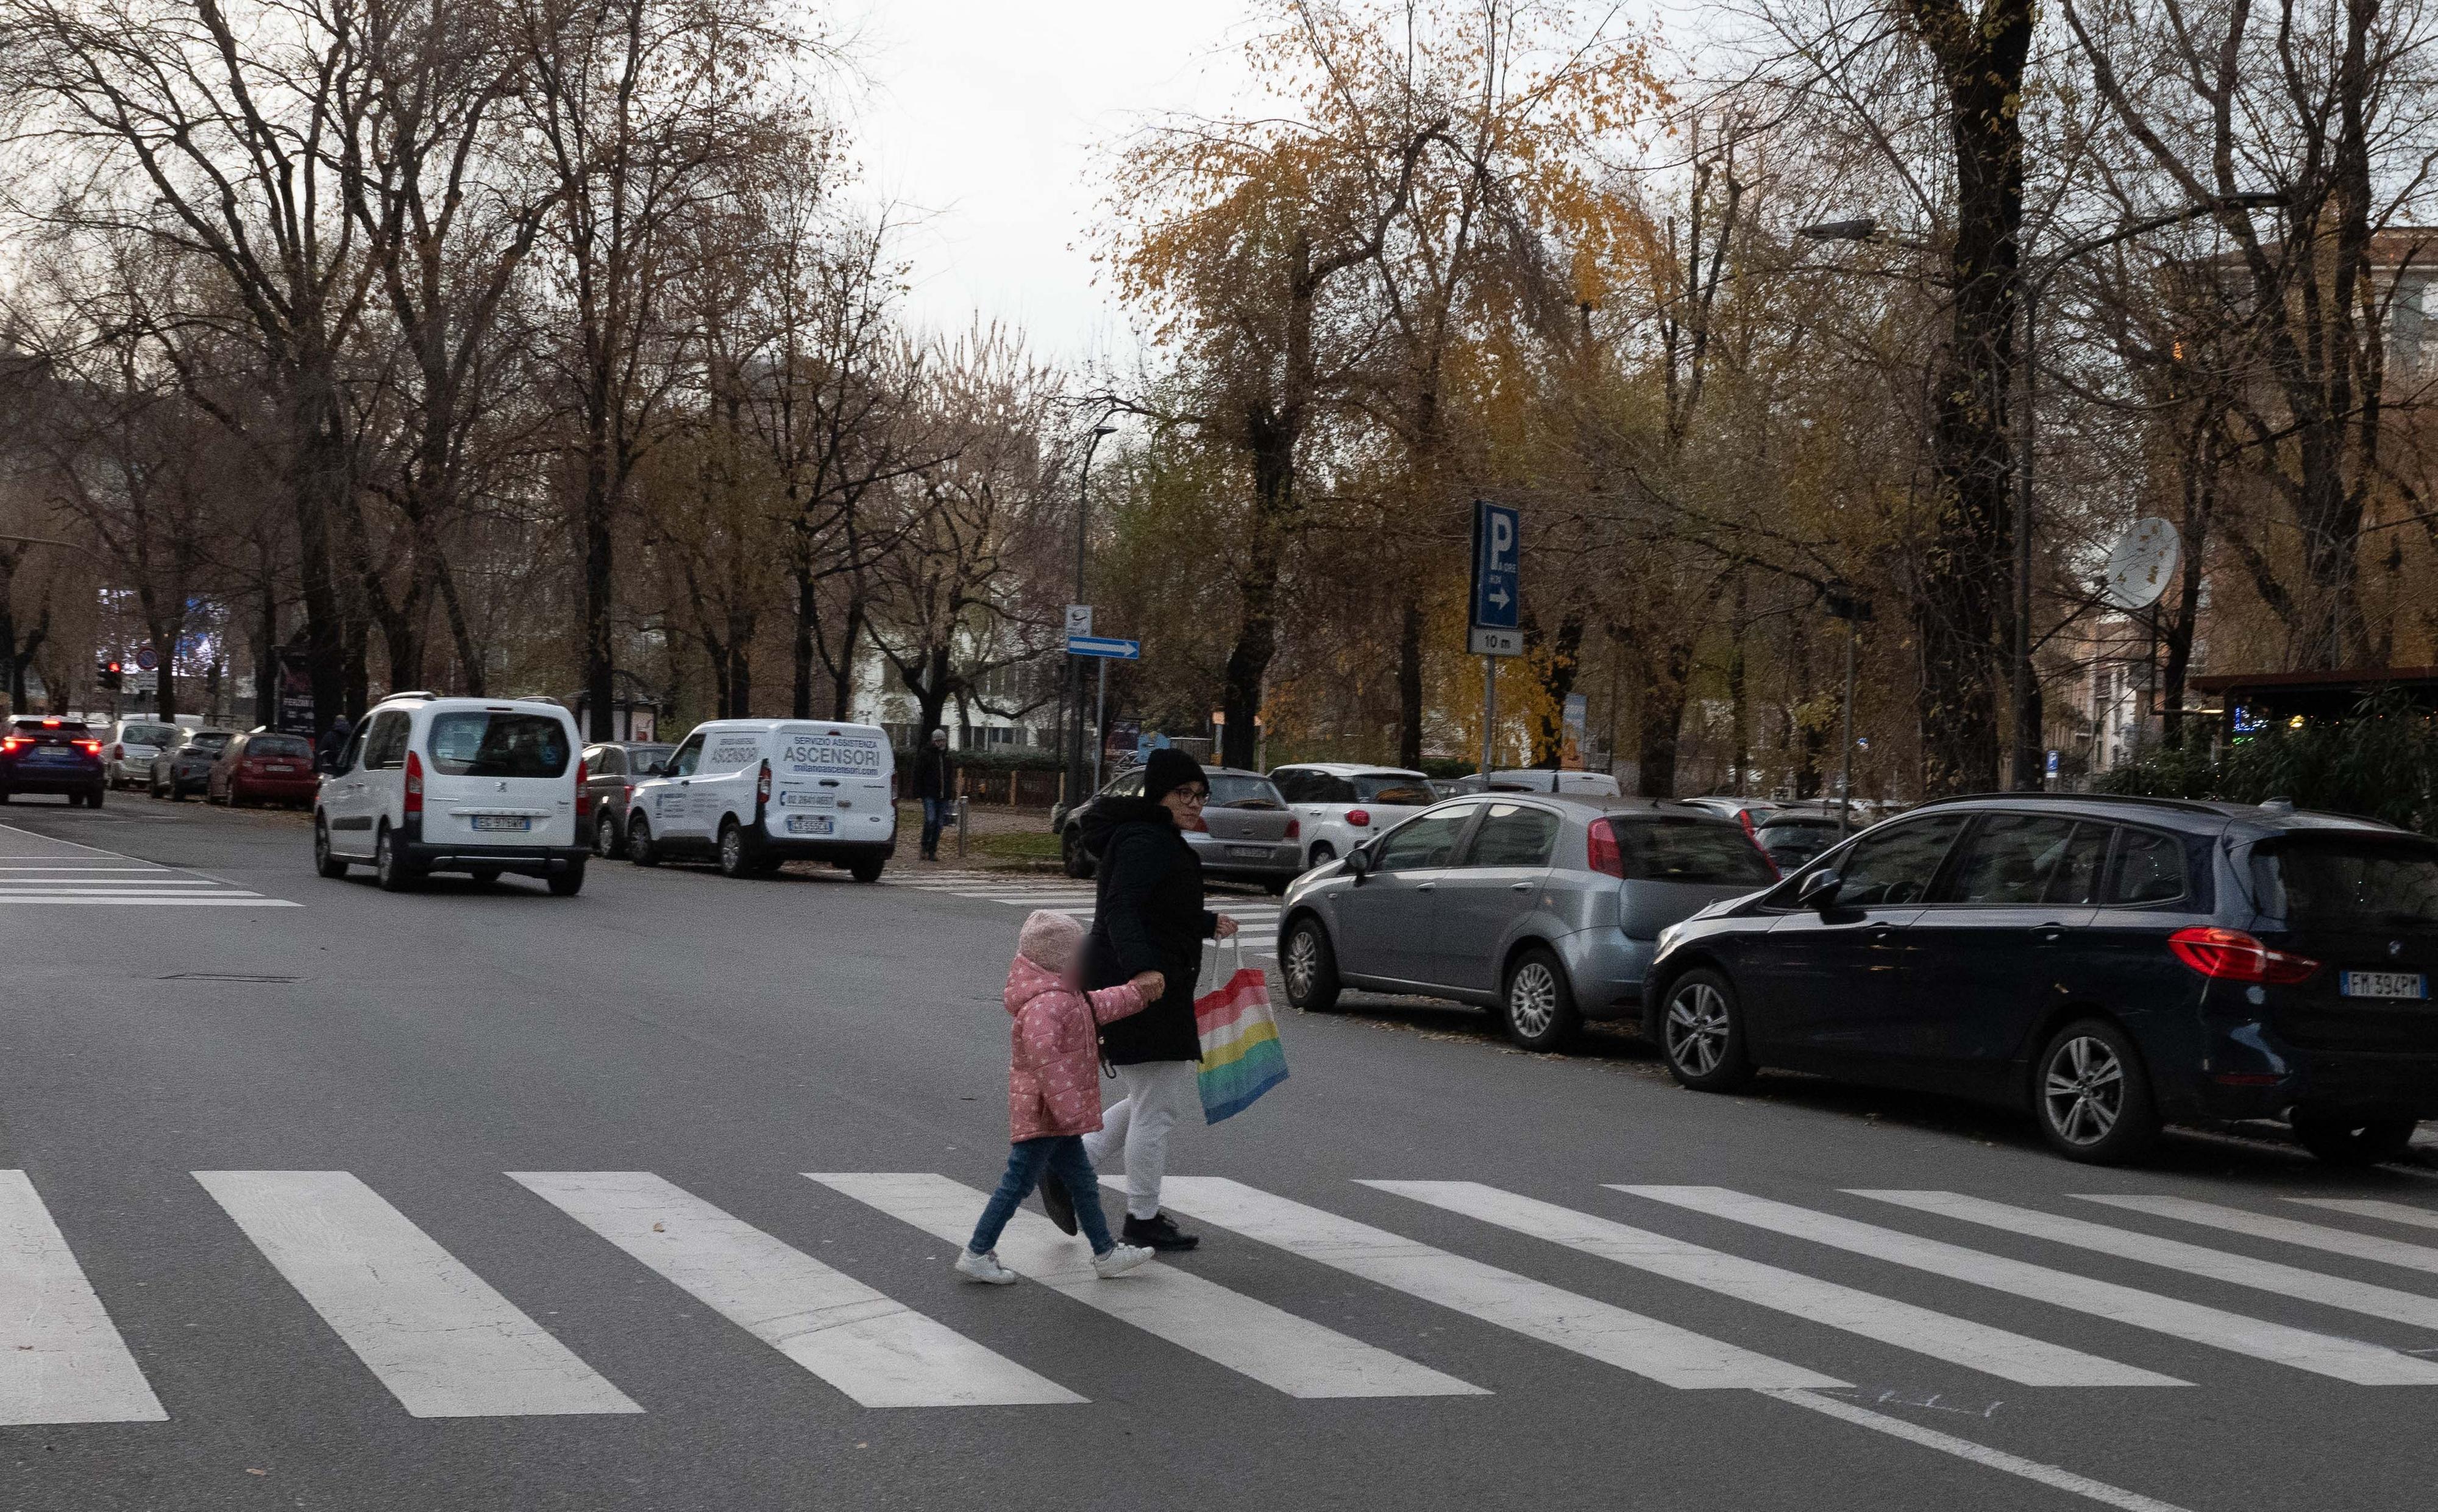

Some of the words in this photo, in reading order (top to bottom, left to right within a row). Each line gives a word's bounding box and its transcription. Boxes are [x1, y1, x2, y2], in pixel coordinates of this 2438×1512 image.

[1491, 513, 1513, 570] P
[1485, 635, 1497, 648] 10
[1501, 639, 1511, 649] m
[795, 736, 831, 746] SERVIZIO
[832, 739, 878, 748] ASSISTENZA
[783, 747, 880, 766] ASCENSORI
[794, 763, 878, 775] milanoascensori.com
[2351, 974, 2370, 994] FM
[2375, 975, 2419, 995] 394PM
